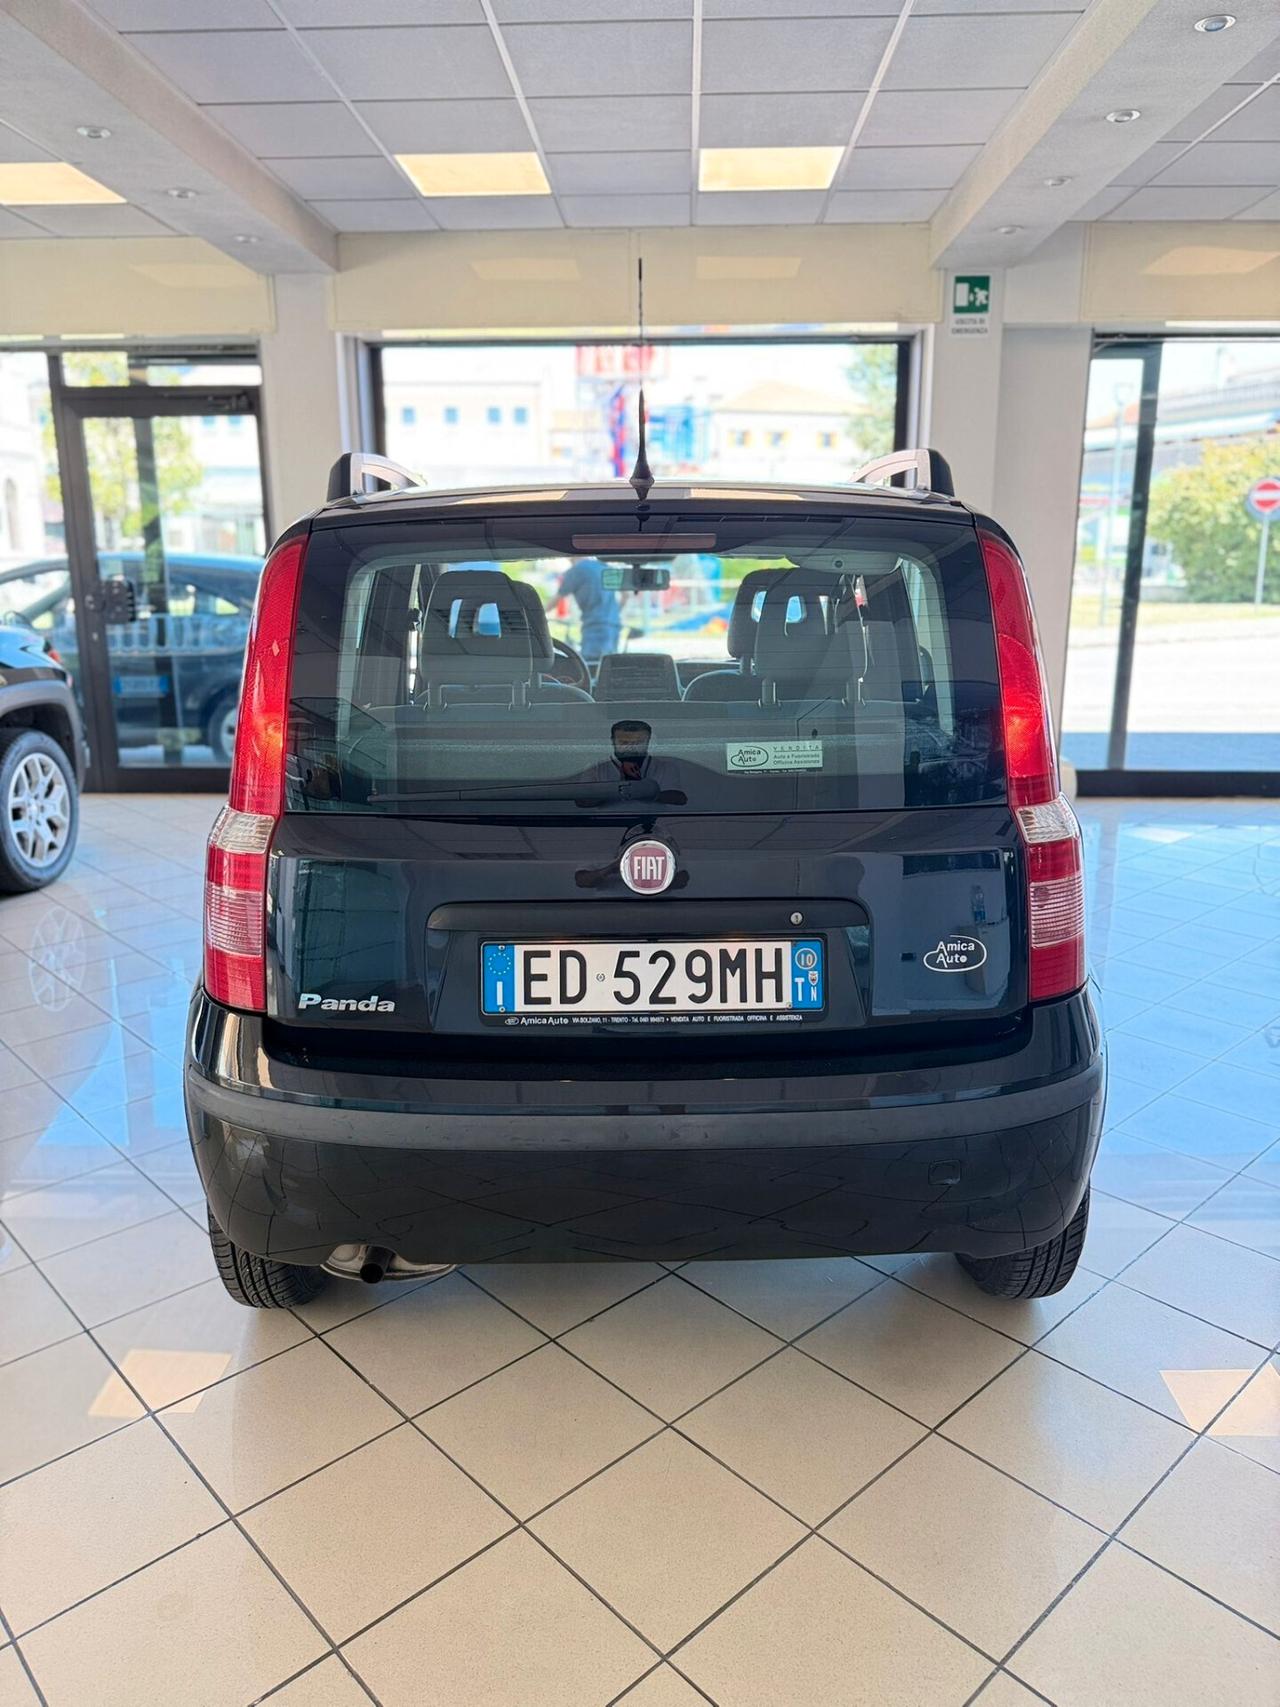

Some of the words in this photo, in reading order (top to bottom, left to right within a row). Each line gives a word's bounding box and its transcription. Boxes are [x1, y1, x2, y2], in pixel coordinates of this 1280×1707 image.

[738, 749, 761, 758] Amica
[738, 756, 757, 765] Auto
[633, 856, 665, 880] FIAT
[936, 940, 975, 956] Amica
[801, 953, 813, 966] 10
[936, 953, 967, 968] Auto
[523, 949, 587, 1005] ED
[613, 948, 784, 1005] 529MH
[298, 993, 395, 1012] Panda
